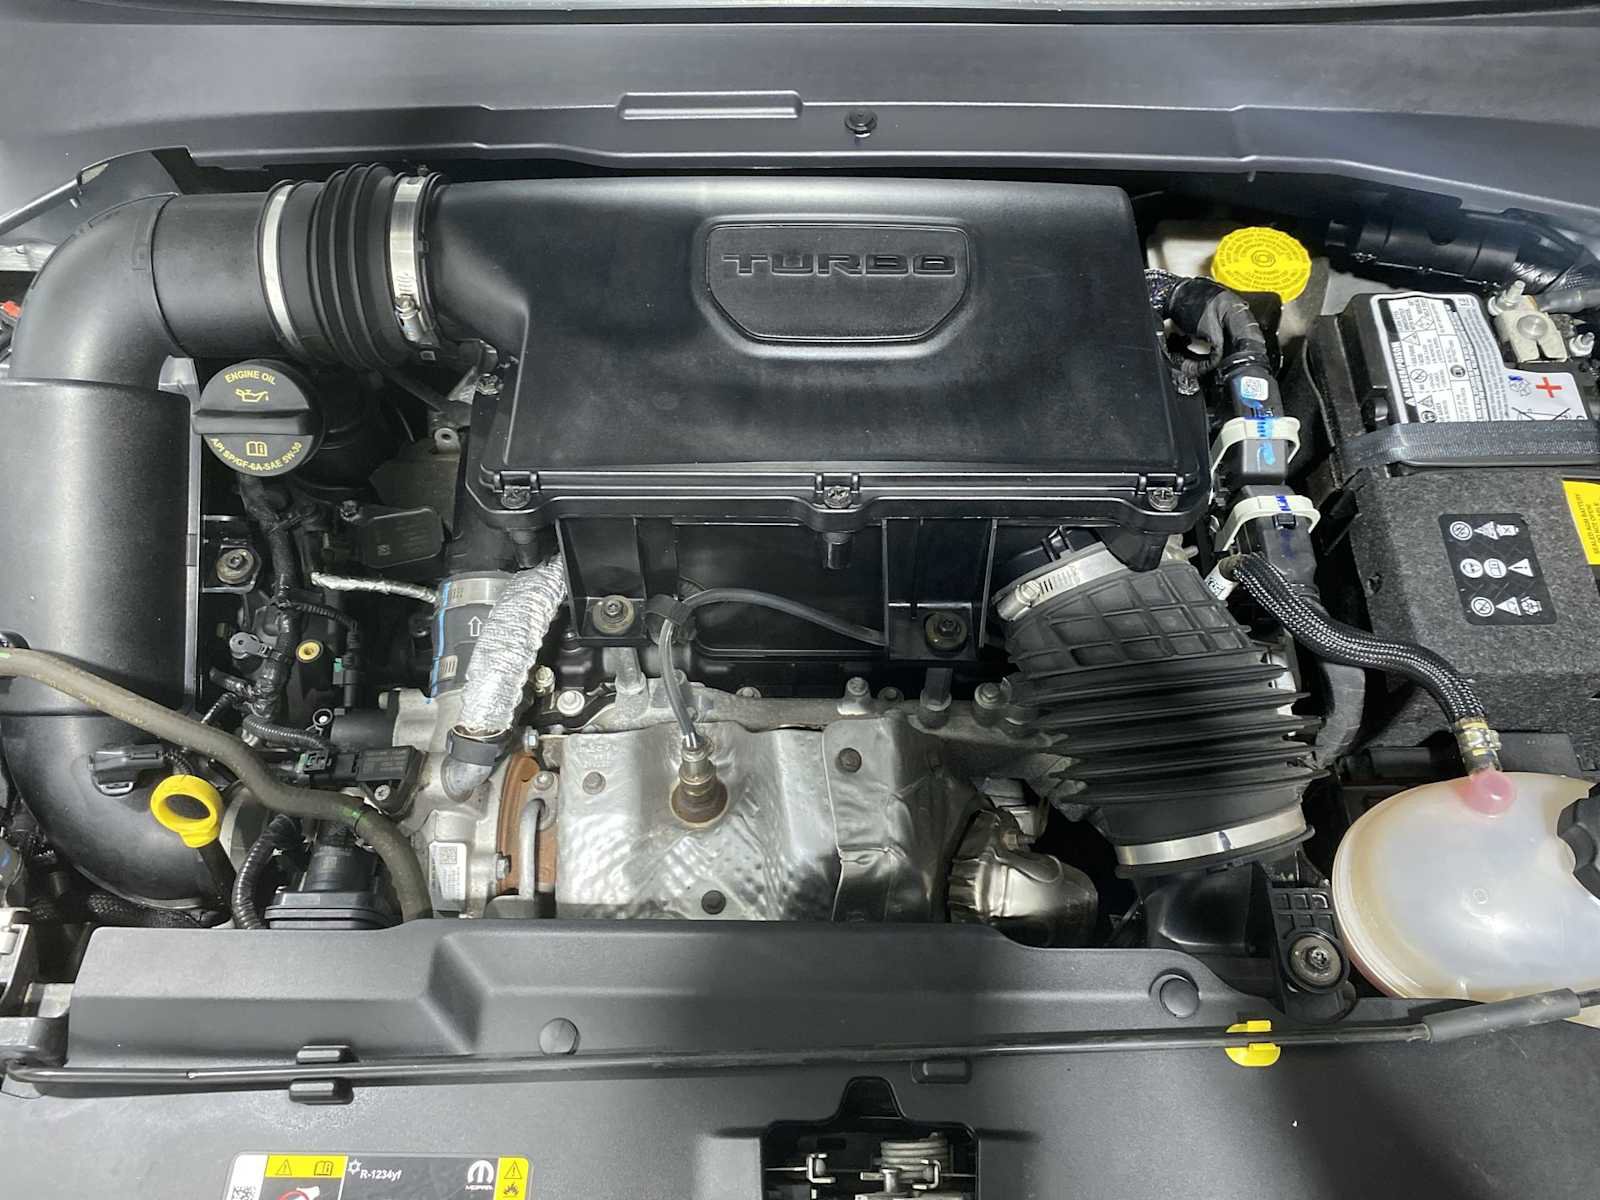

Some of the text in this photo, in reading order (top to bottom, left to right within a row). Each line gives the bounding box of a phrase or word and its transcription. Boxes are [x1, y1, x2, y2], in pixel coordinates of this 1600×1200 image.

[721, 254, 956, 277] TURBO
[224, 369, 277, 385] ENGINE OIL
[210, 438, 225, 453] API
[282, 441, 303, 464] 5W-30
